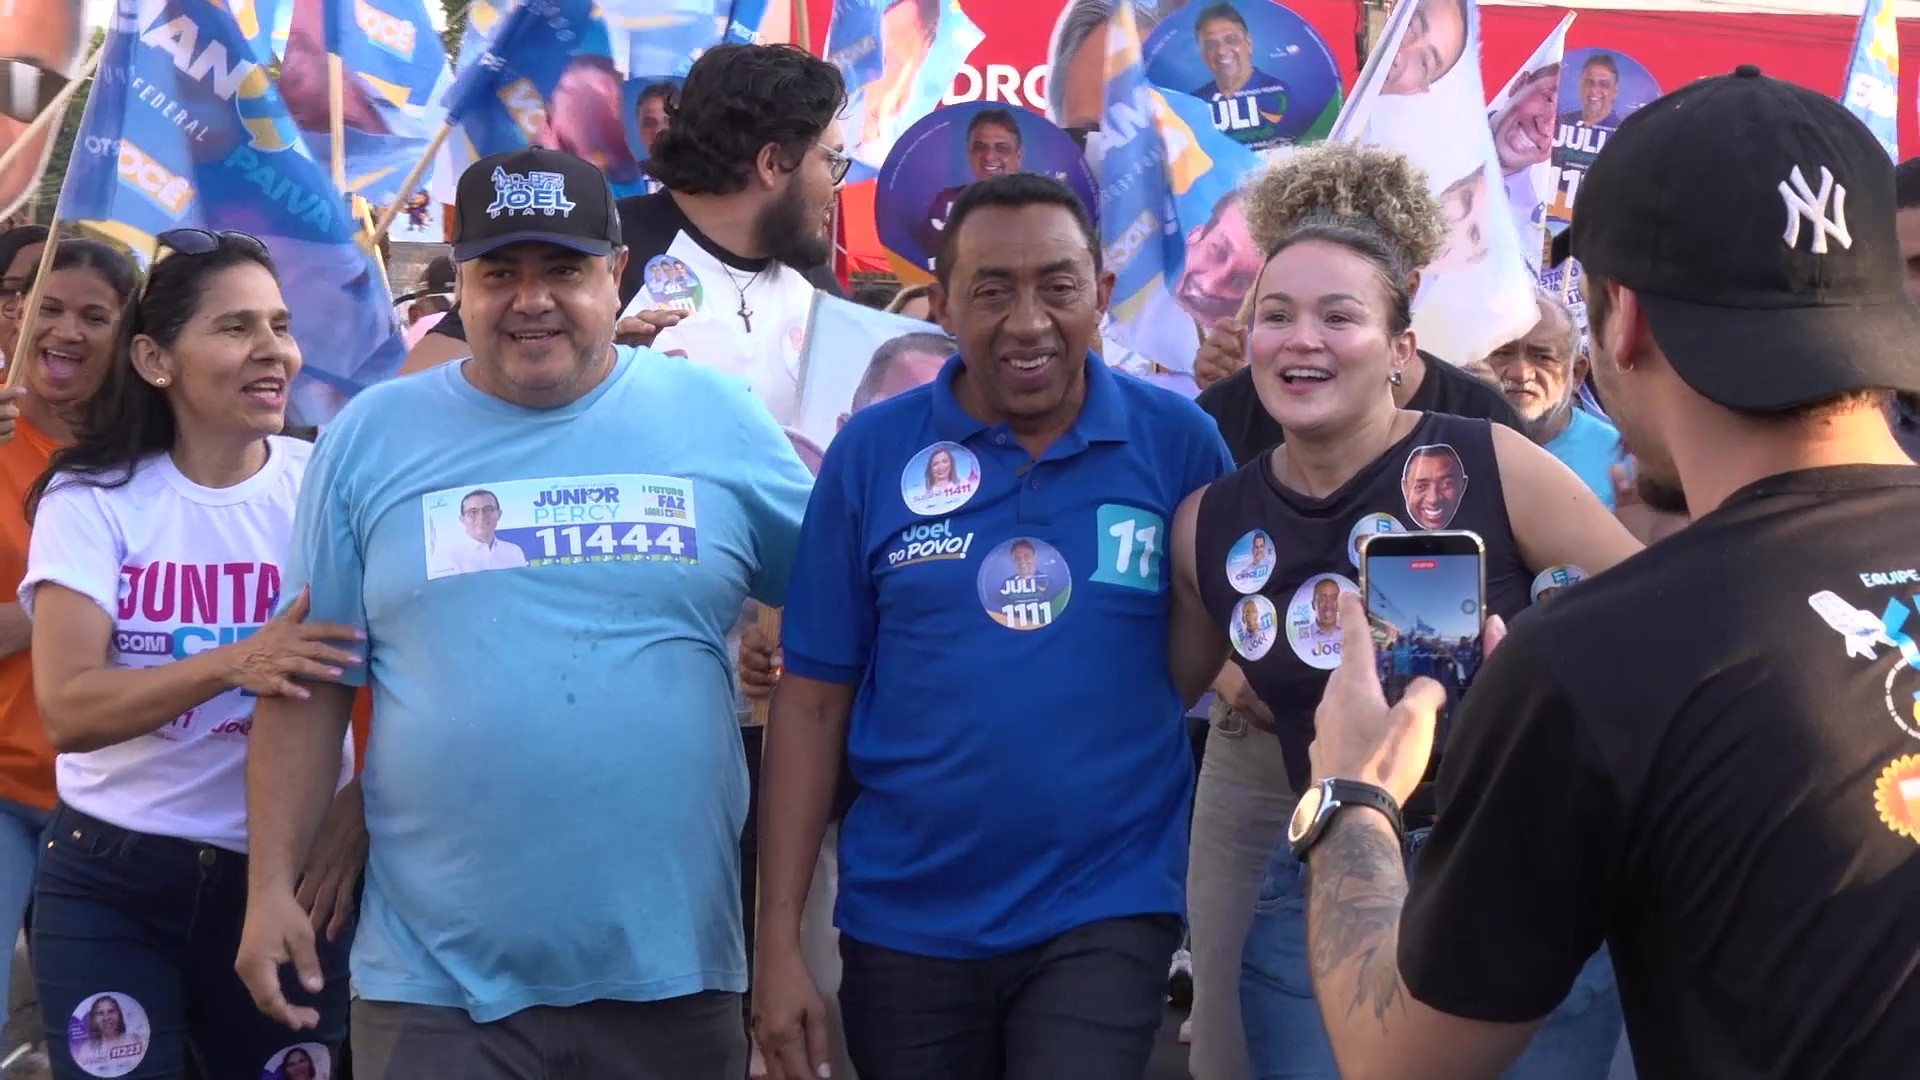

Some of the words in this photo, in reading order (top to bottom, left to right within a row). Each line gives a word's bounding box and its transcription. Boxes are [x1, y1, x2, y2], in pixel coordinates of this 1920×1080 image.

[1206, 93, 1261, 132] ÚLI
[223, 145, 332, 232] PAIVA
[486, 187, 577, 214] JOEL
[1777, 164, 1853, 254] NY
[534, 503, 620, 524] PERCY
[535, 524, 685, 557] 11444
[902, 519, 952, 542] Joel
[887, 548, 906, 563] DO
[907, 532, 975, 560] POVO!
[1109, 518, 1157, 578] 11
[1001, 601, 1053, 628] 1111
[117, 630, 167, 652] COM
